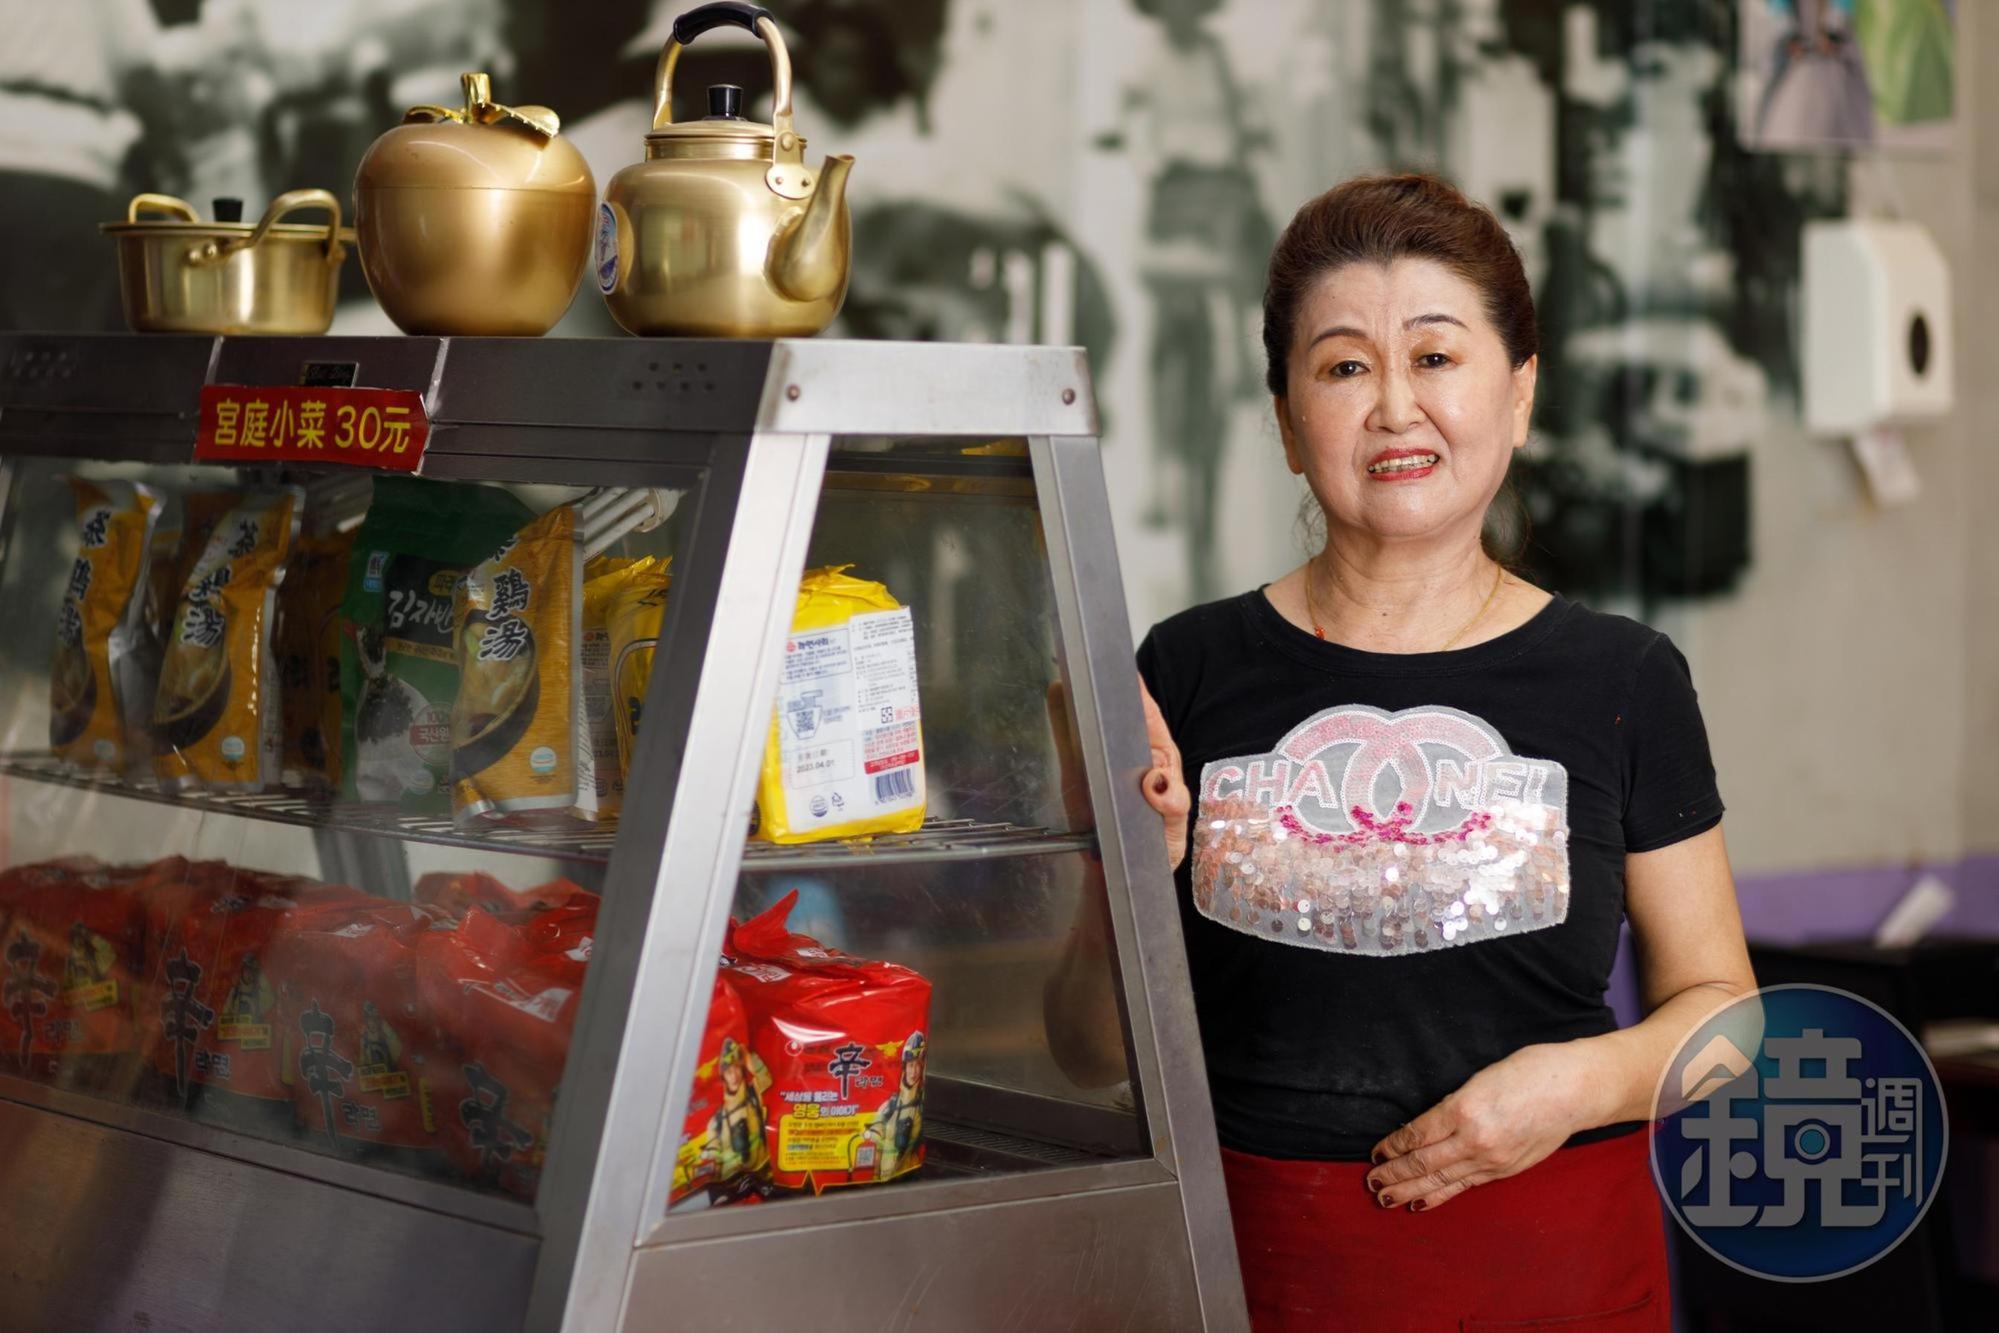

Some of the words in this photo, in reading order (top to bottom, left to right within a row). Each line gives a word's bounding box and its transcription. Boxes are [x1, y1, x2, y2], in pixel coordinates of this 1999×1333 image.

[214, 398, 327, 449] 宮庭小菜
[334, 404, 411, 453] 30元
[159, 945, 216, 1098] 辛
[299, 997, 354, 1150] 辛
[827, 1041, 872, 1101] 辛
